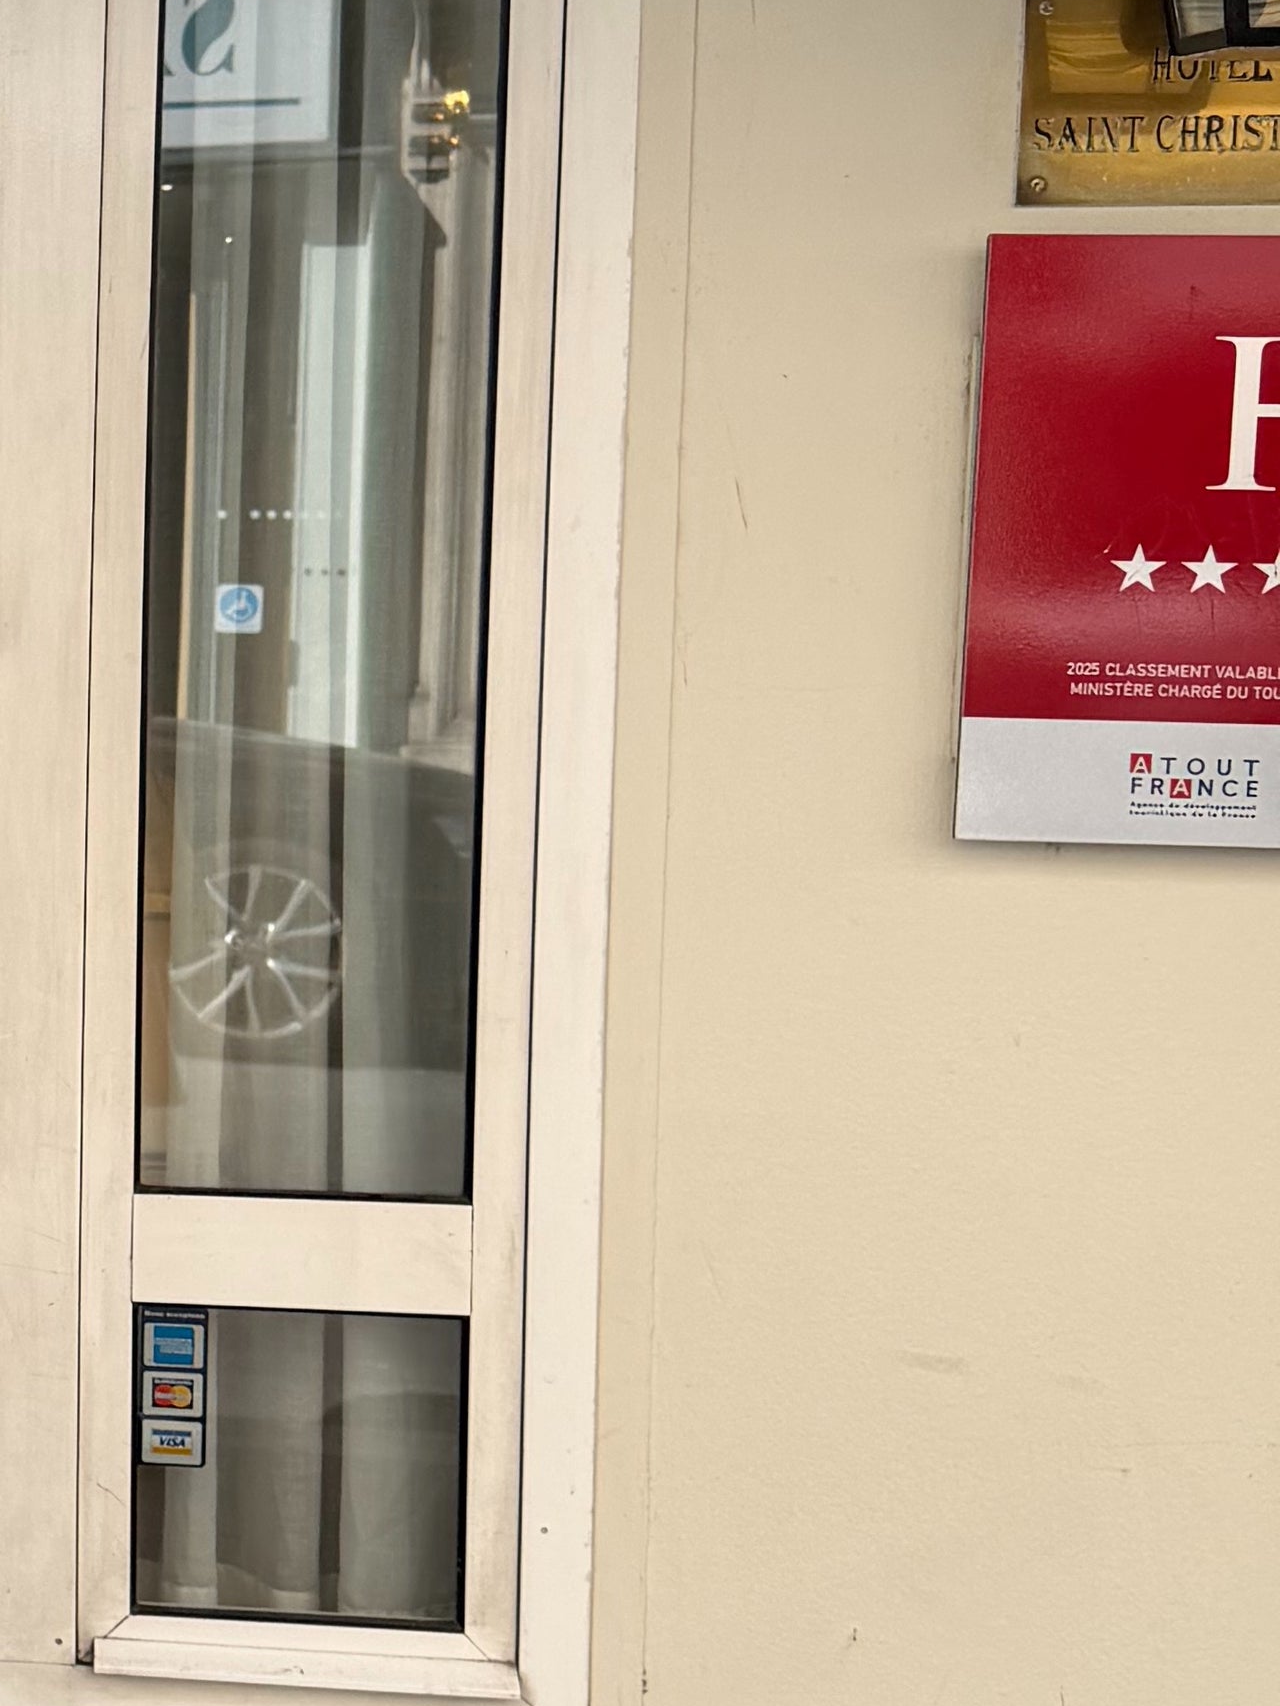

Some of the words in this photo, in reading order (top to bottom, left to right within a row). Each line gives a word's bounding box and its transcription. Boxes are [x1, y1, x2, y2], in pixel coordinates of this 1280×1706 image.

[1033, 116, 1145, 153] SAINT
[1066, 662, 1100, 676] 2025
[1105, 663, 1212, 679] CLASSEMENT
[1070, 680, 1154, 697] MINISTÈRE
[1158, 683, 1222, 699] CHARGÉ
[1226, 686, 1248, 700] DU
[1130, 753, 1260, 777] ATOUT
[1130, 777, 1260, 799] FRANCE
[159, 1436, 186, 1448] VISA
